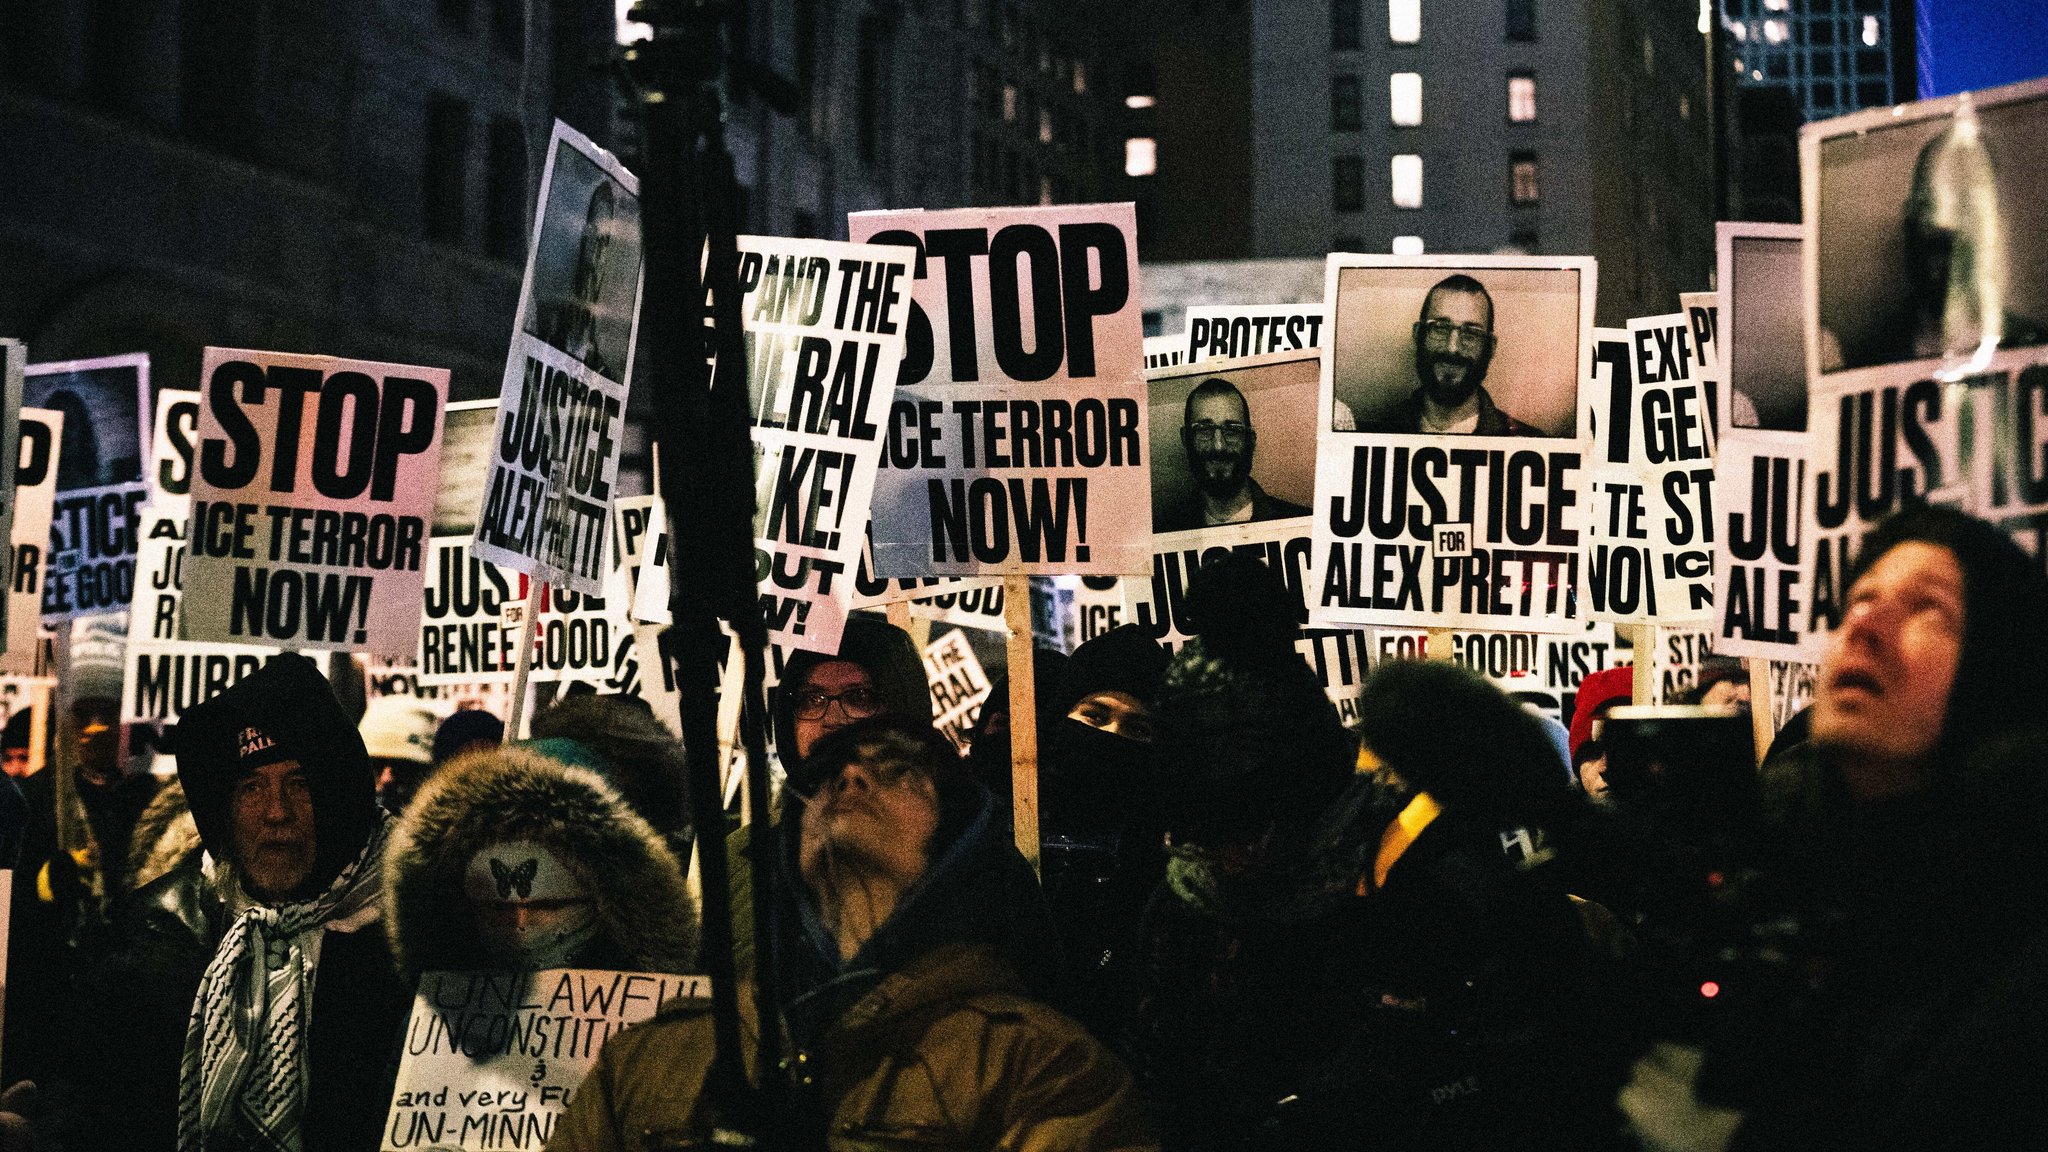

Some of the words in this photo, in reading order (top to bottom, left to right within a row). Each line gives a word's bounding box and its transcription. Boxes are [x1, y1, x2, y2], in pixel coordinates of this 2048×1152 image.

[738, 251, 831, 327] PAND
[834, 259, 906, 335] THE
[866, 222, 1130, 386] STOP
[1188, 315, 1323, 364] PROTEST
[201, 360, 438, 502] STOP
[500, 355, 621, 502] JUSTICE
[952, 397, 1141, 469] TERROR
[479, 465, 545, 557] ALEX
[927, 477, 1091, 564] NOW!
[1329, 445, 1581, 547] JUSTICE
[192, 501, 258, 558] ICE
[268, 506, 425, 572] TERROR
[1439, 531, 1466, 553] FOR
[230, 567, 374, 644] NOW!
[1320, 541, 1425, 613] ALEX
[1431, 547, 1579, 619] PRETTI
[423, 623, 515, 675] RENEE
[529, 618, 609, 672] GOOD
[396, 1086, 448, 1107] and
[459, 1090, 528, 1112] very
